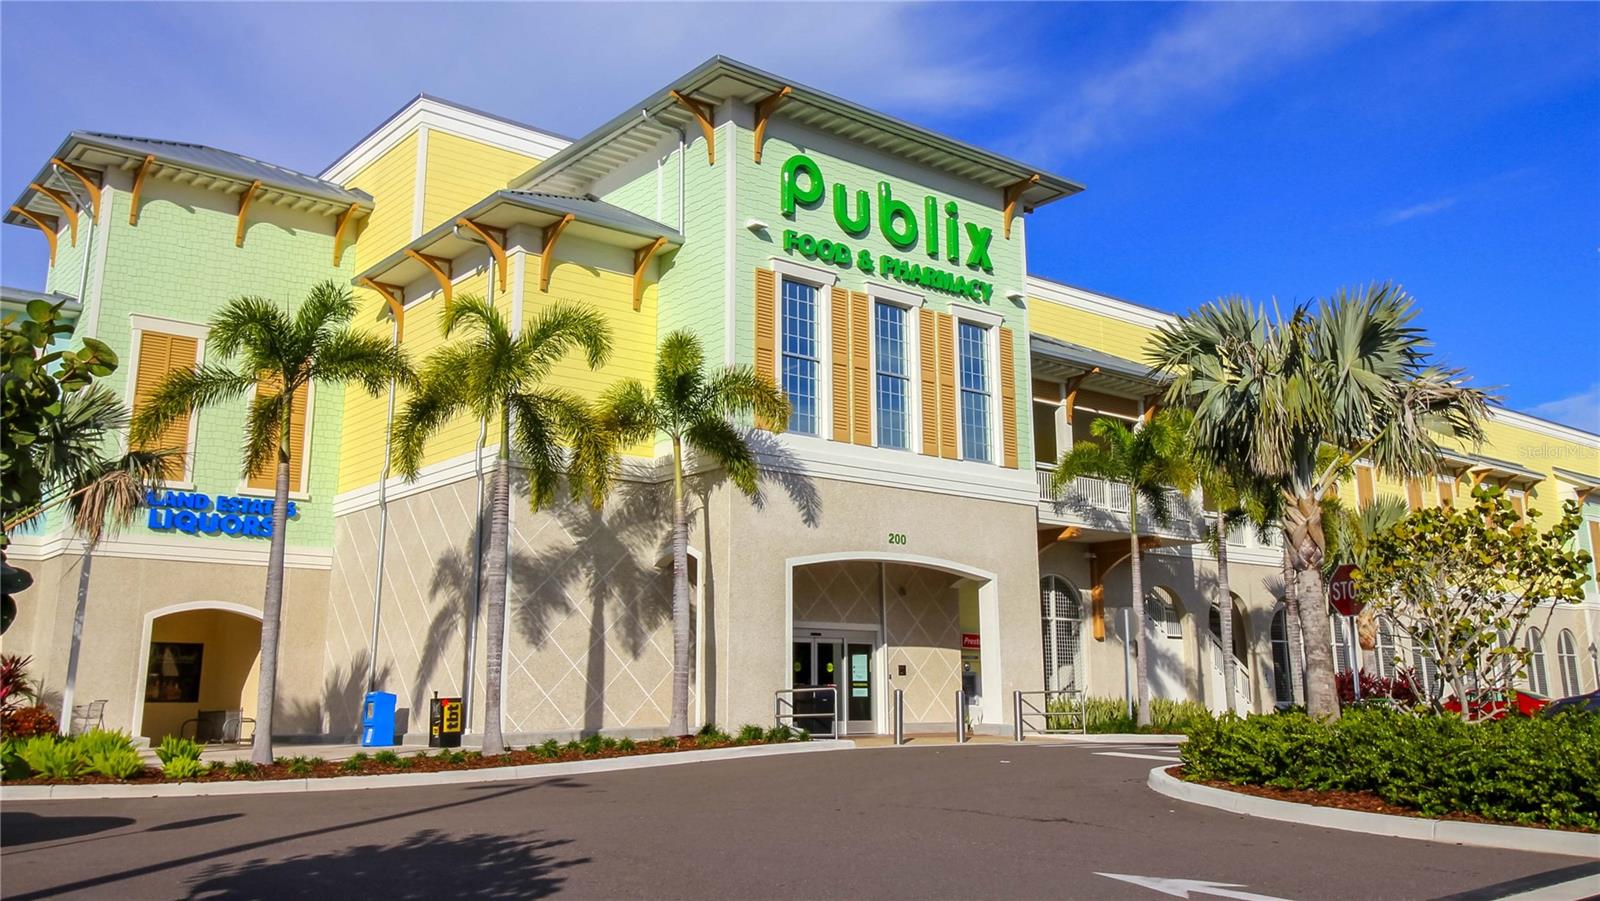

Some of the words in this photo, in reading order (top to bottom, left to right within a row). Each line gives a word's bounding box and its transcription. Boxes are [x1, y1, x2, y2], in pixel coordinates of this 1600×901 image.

[781, 154, 993, 271] Publix
[783, 229, 852, 266] FOOD
[857, 249, 874, 272] &
[879, 255, 993, 301] PHARMACY
[146, 490, 209, 509] LAND
[217, 495, 297, 518] ESTATS
[148, 508, 273, 538] LIQUORS
[888, 533, 906, 545] 200
[1332, 580, 1360, 601] STO
[963, 636, 980, 646] Prest
[446, 704, 459, 729] tbt
